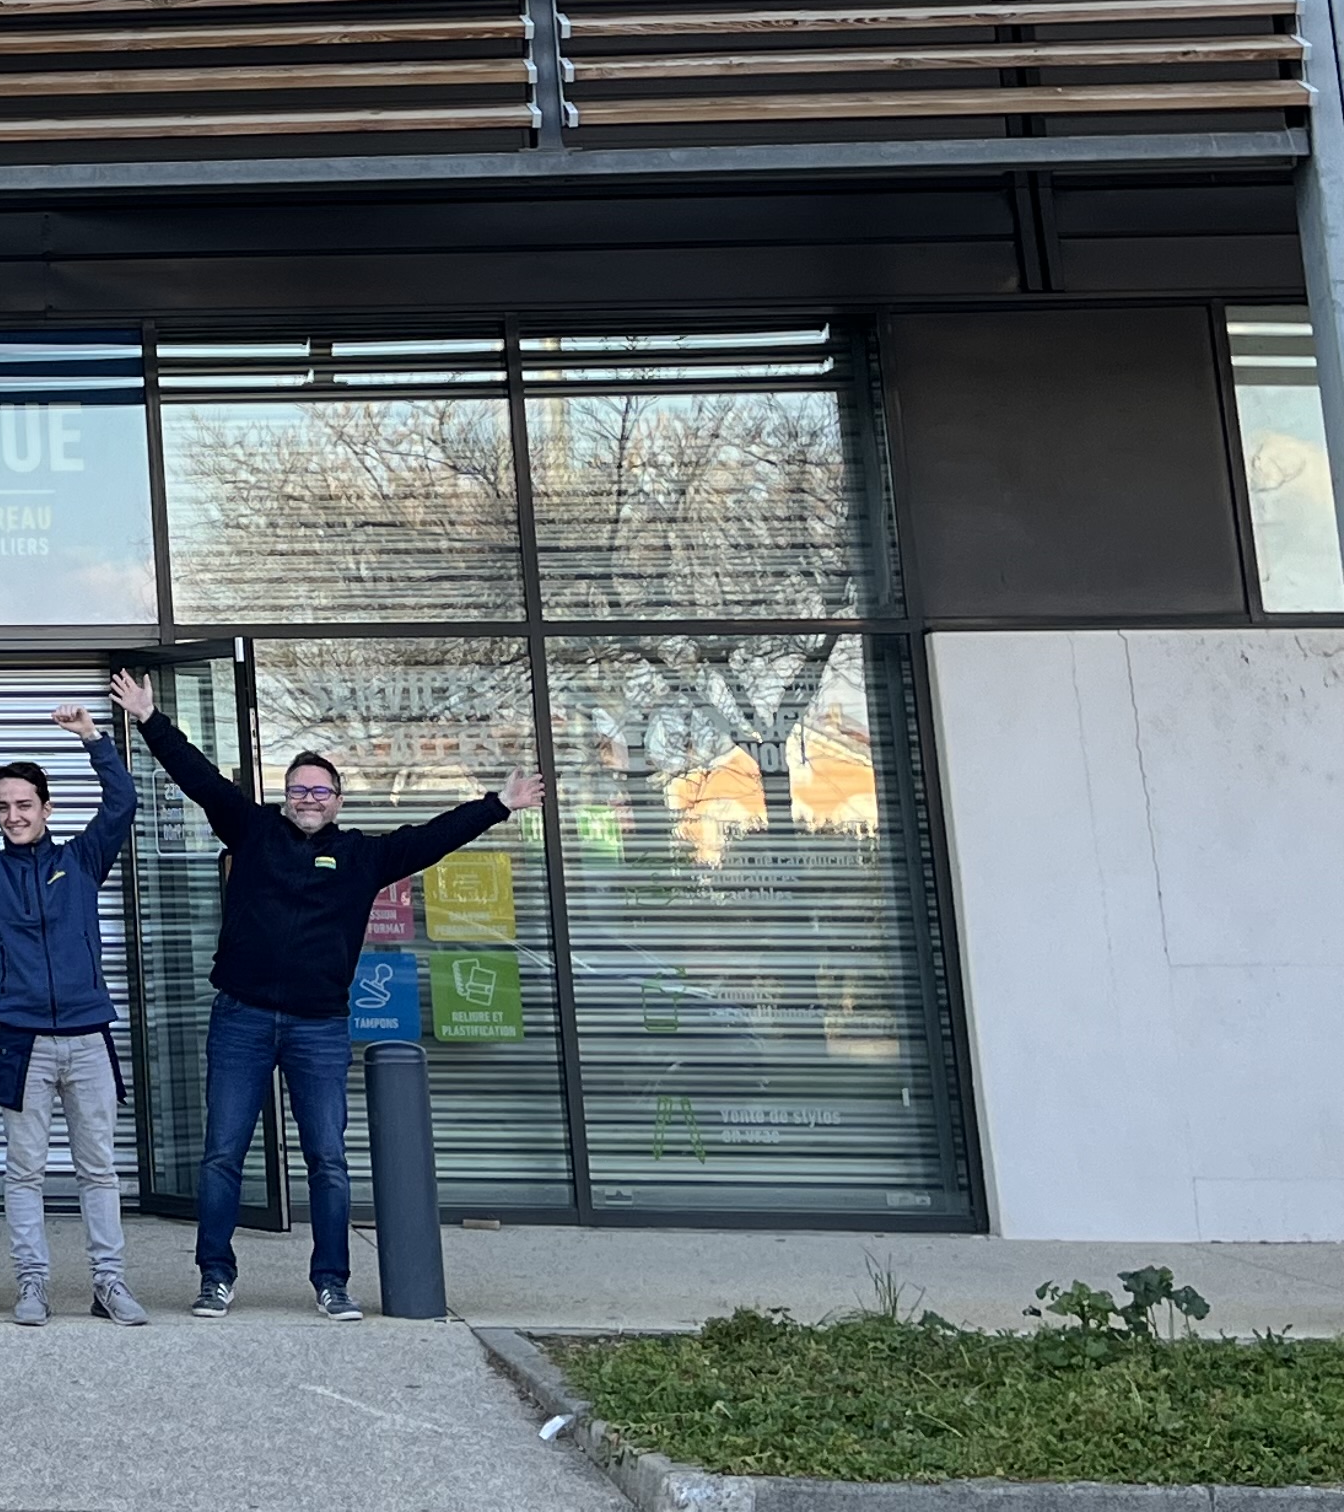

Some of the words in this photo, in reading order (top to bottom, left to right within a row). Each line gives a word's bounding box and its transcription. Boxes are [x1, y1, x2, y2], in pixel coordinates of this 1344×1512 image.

[354, 1017, 400, 1029] TAMPONS
[452, 1011, 489, 1023] RELIURE
[492, 1011, 504, 1022] ET
[441, 1025, 517, 1037] PLASTIFICATION
